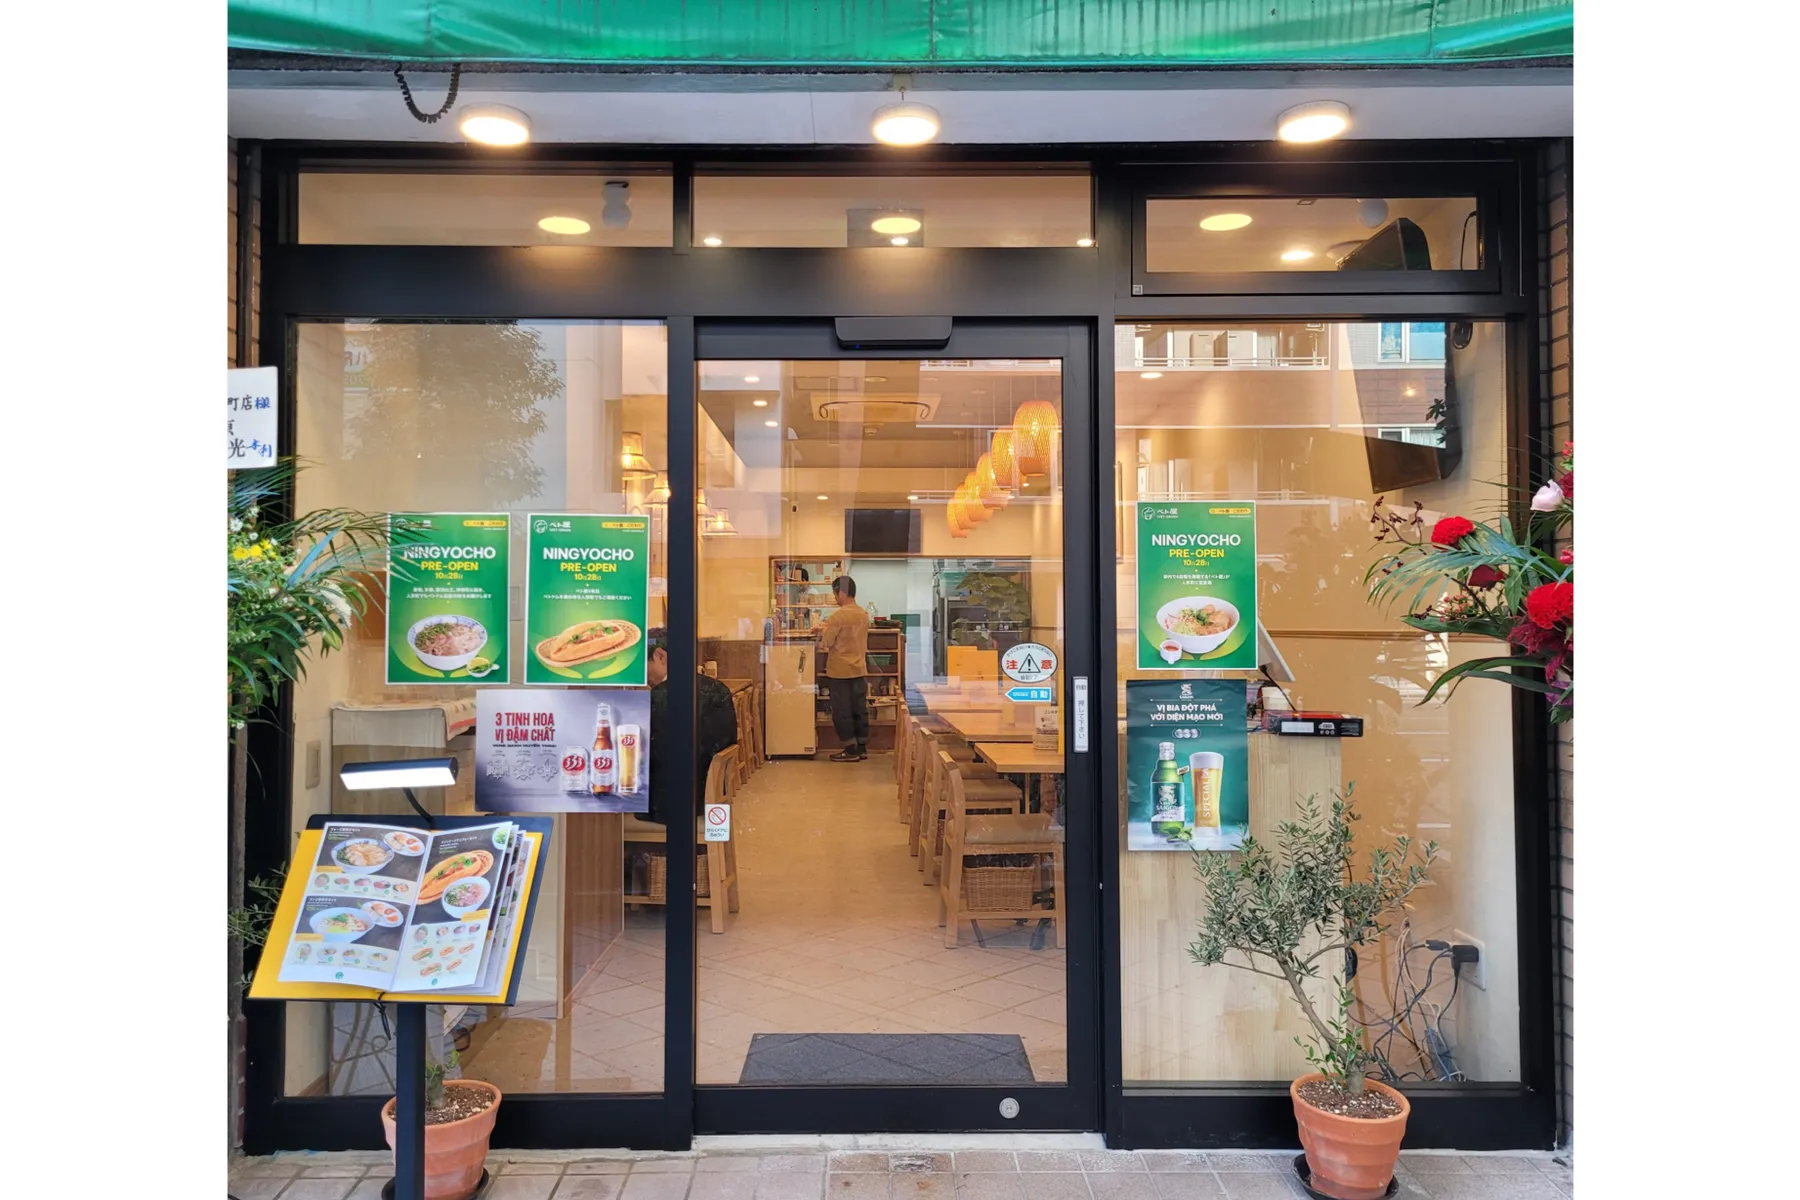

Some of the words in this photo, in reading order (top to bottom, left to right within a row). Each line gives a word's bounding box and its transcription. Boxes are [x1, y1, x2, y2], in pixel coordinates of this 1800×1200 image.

[1151, 534, 1241, 546] NINGYOCHO
[404, 546, 496, 559] NINGYOCHO
[543, 547, 634, 560] NINGYOCHO
[1169, 549, 1224, 557] PRE-OPEN
[421, 561, 479, 570] PRE-OPEN
[560, 562, 617, 572] PRE-OPEN
[1006, 660, 1018, 670] 注
[1040, 660, 1053, 669] 意
[495, 713, 503, 726] 3
[505, 713, 530, 726] TINH
[565, 756, 582, 769] 333
[596, 757, 612, 768] 333
[1203, 781, 1211, 818] SPECIAL
